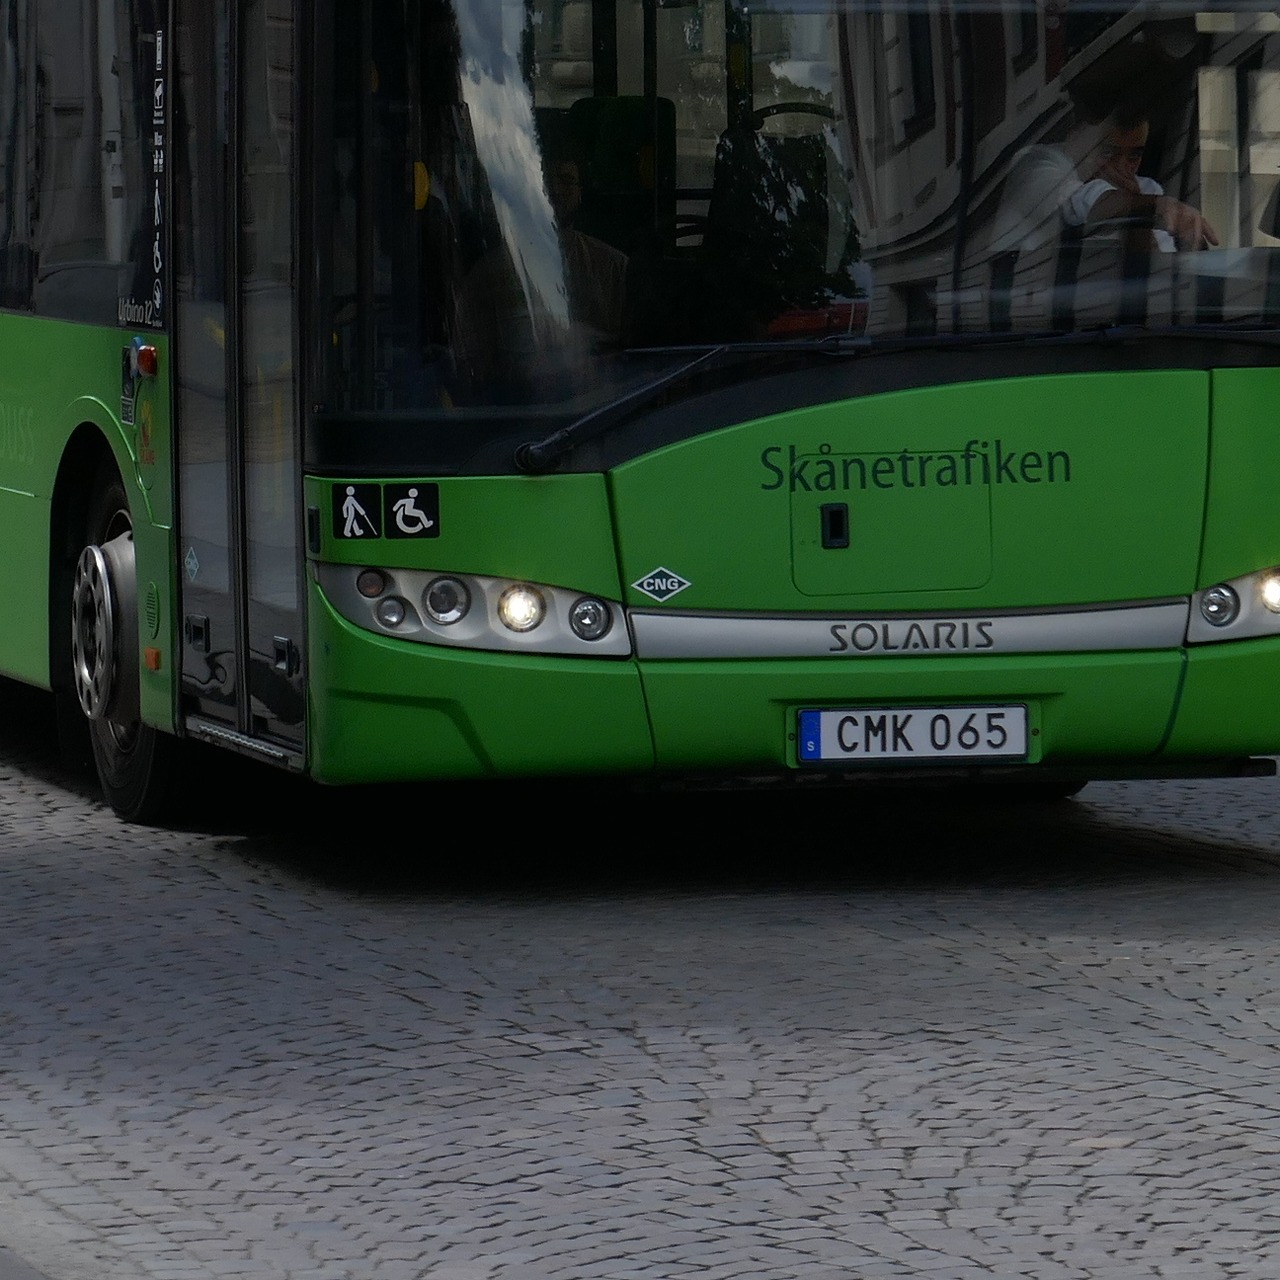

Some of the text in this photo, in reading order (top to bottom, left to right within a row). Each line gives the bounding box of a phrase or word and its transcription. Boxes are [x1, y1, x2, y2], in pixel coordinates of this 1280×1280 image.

[118, 297, 144, 323] Urbino
[761, 440, 1070, 492] Skånetrafiken
[642, 578, 679, 590] CNG
[829, 621, 994, 652] SOLARIS
[806, 712, 1008, 753] S CMK 065
